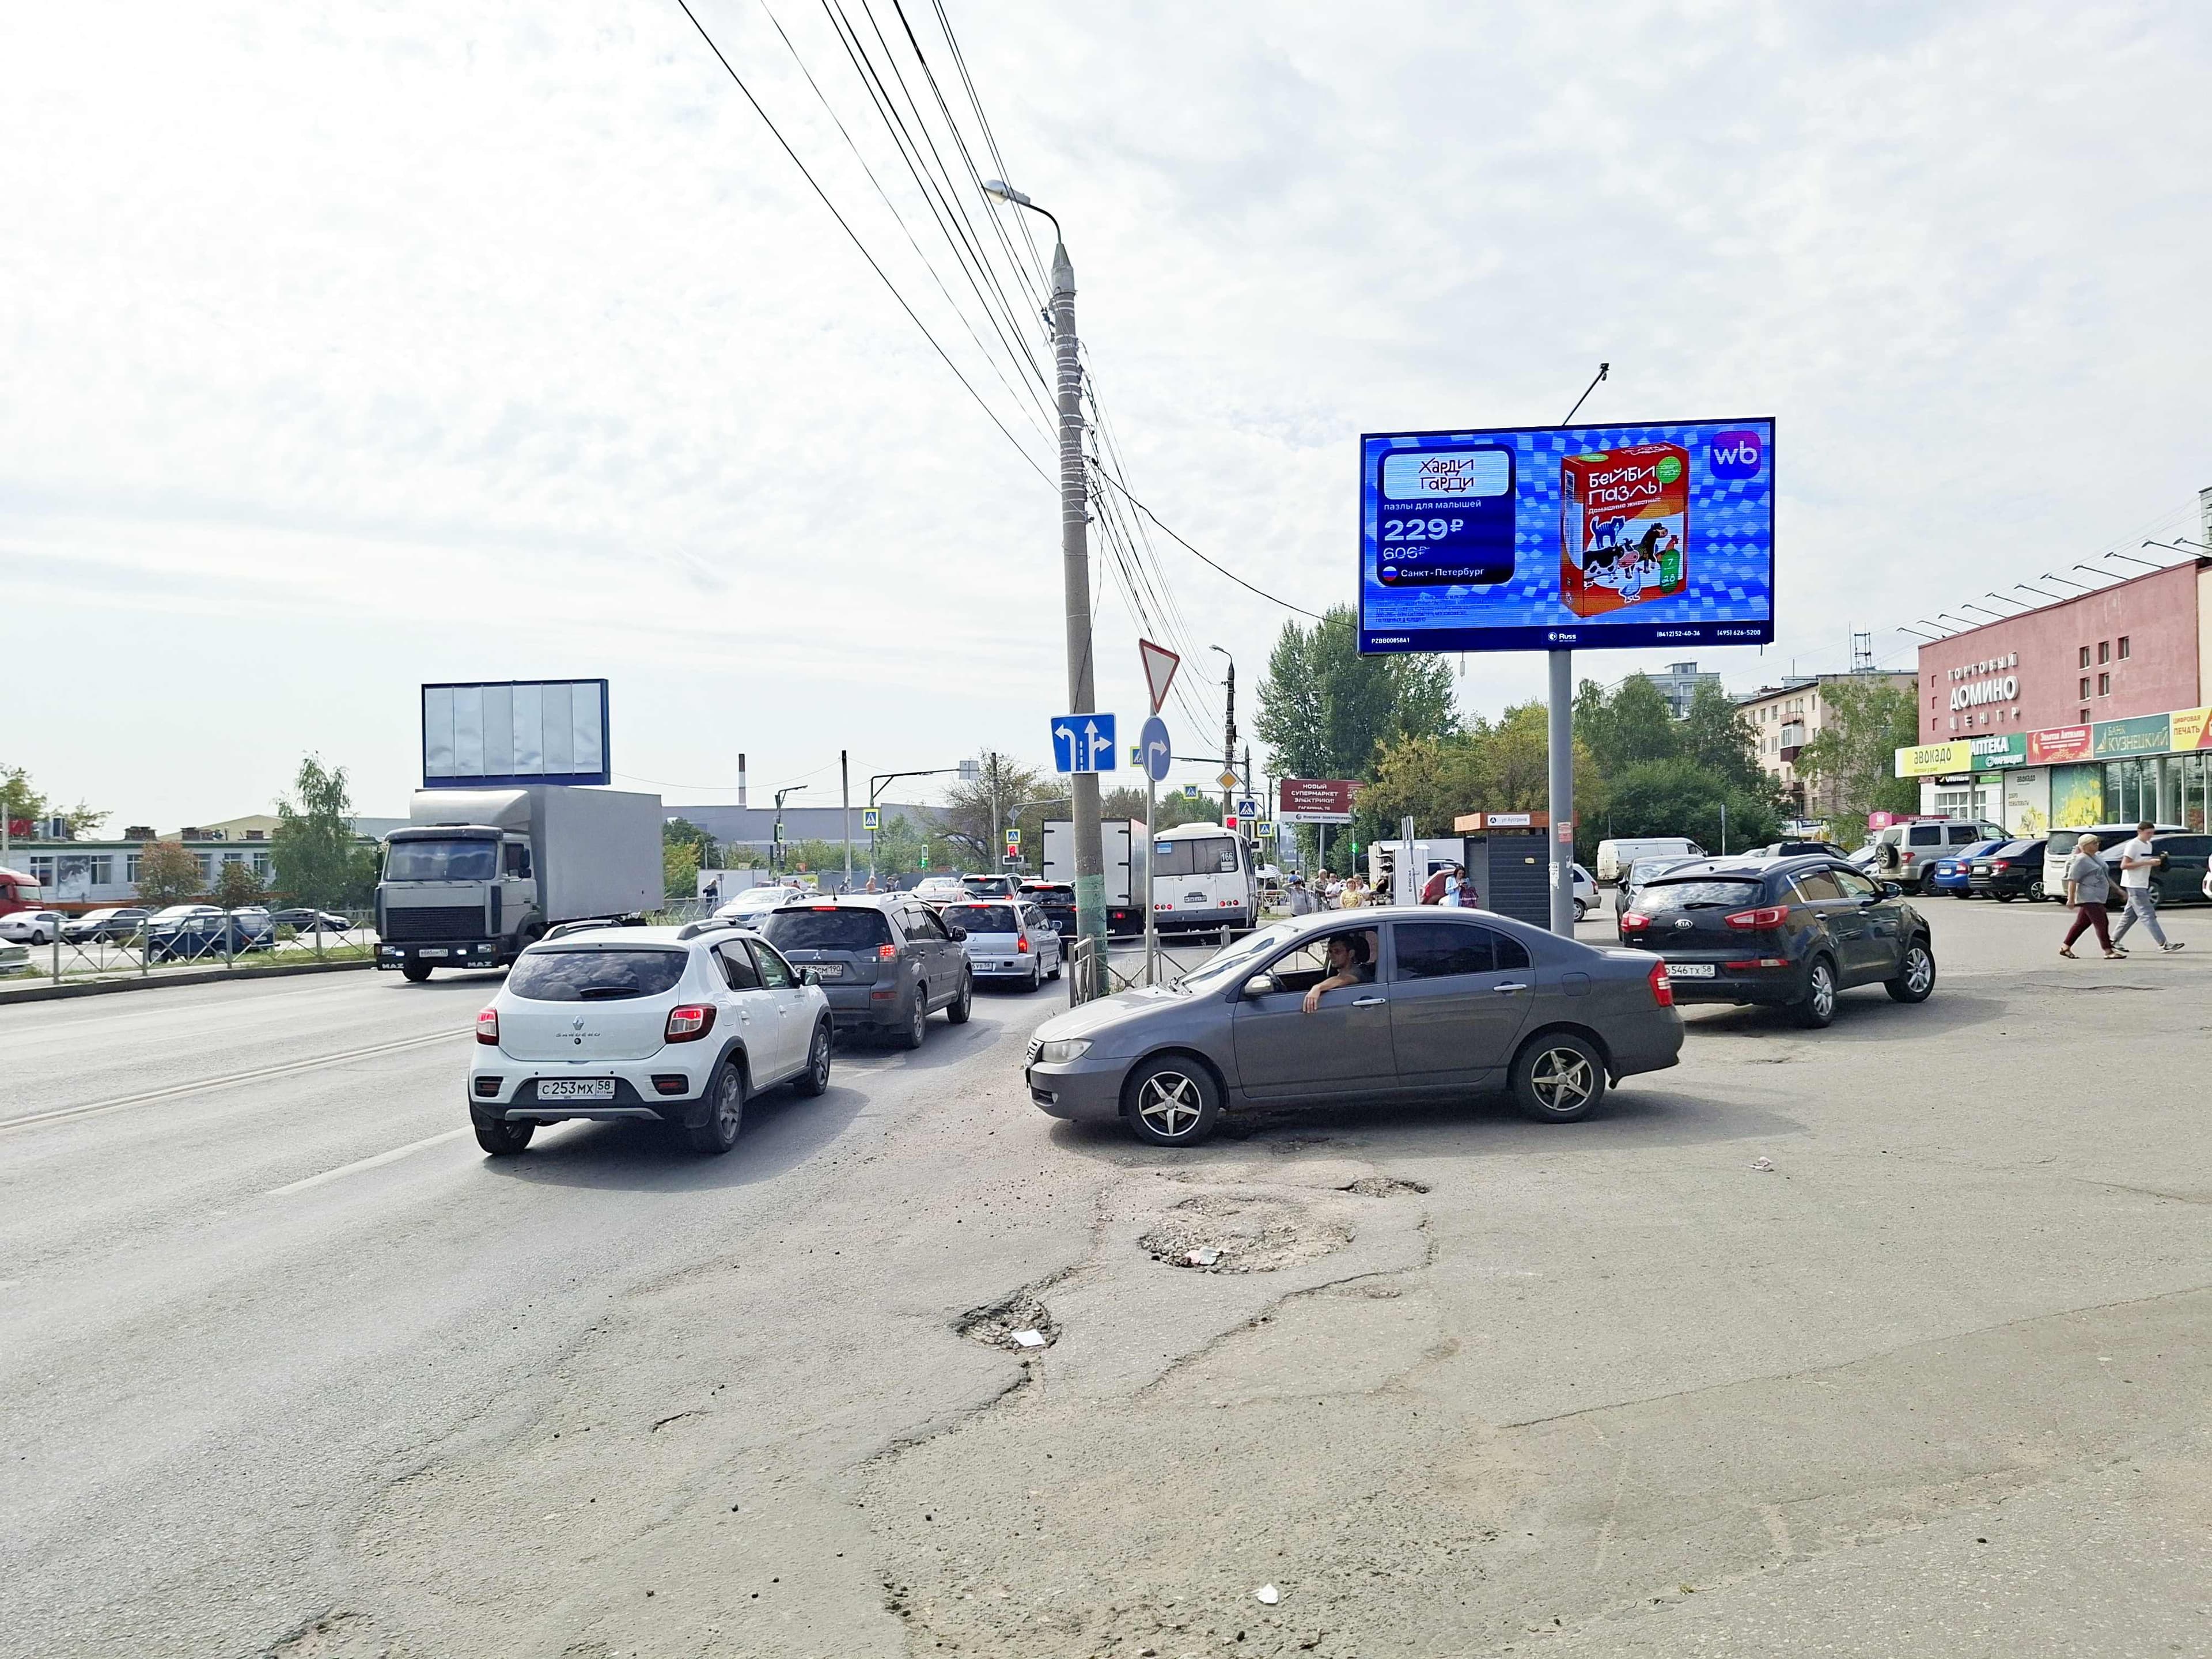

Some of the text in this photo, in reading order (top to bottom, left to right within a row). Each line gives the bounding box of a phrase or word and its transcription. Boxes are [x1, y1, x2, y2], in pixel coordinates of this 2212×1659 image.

[1714, 441, 1758, 464] wb
[1418, 457, 1474, 476] Харди
[1420, 477, 1474, 493] Гарди
[1415, 502, 1433, 510] для
[1435, 499, 1481, 509] малышей
[1948, 651, 2018, 681] ТОРГОВЫЙ
[1950, 676, 2020, 711] ДОМИНО
[1949, 707, 2020, 730] ЦЕНТР
[2108, 725, 2126, 736] БАНК
[2108, 726, 2168, 752] КУЗНЕЦКИЙ
[2173, 725, 2200, 736] ПЕЧАТЬ
[1971, 737, 2009, 755] АПТЕКА
[1914, 747, 1952, 764] авокадо
[1221, 852, 1233, 861] 166
[598, 1081, 611, 1090] 58
